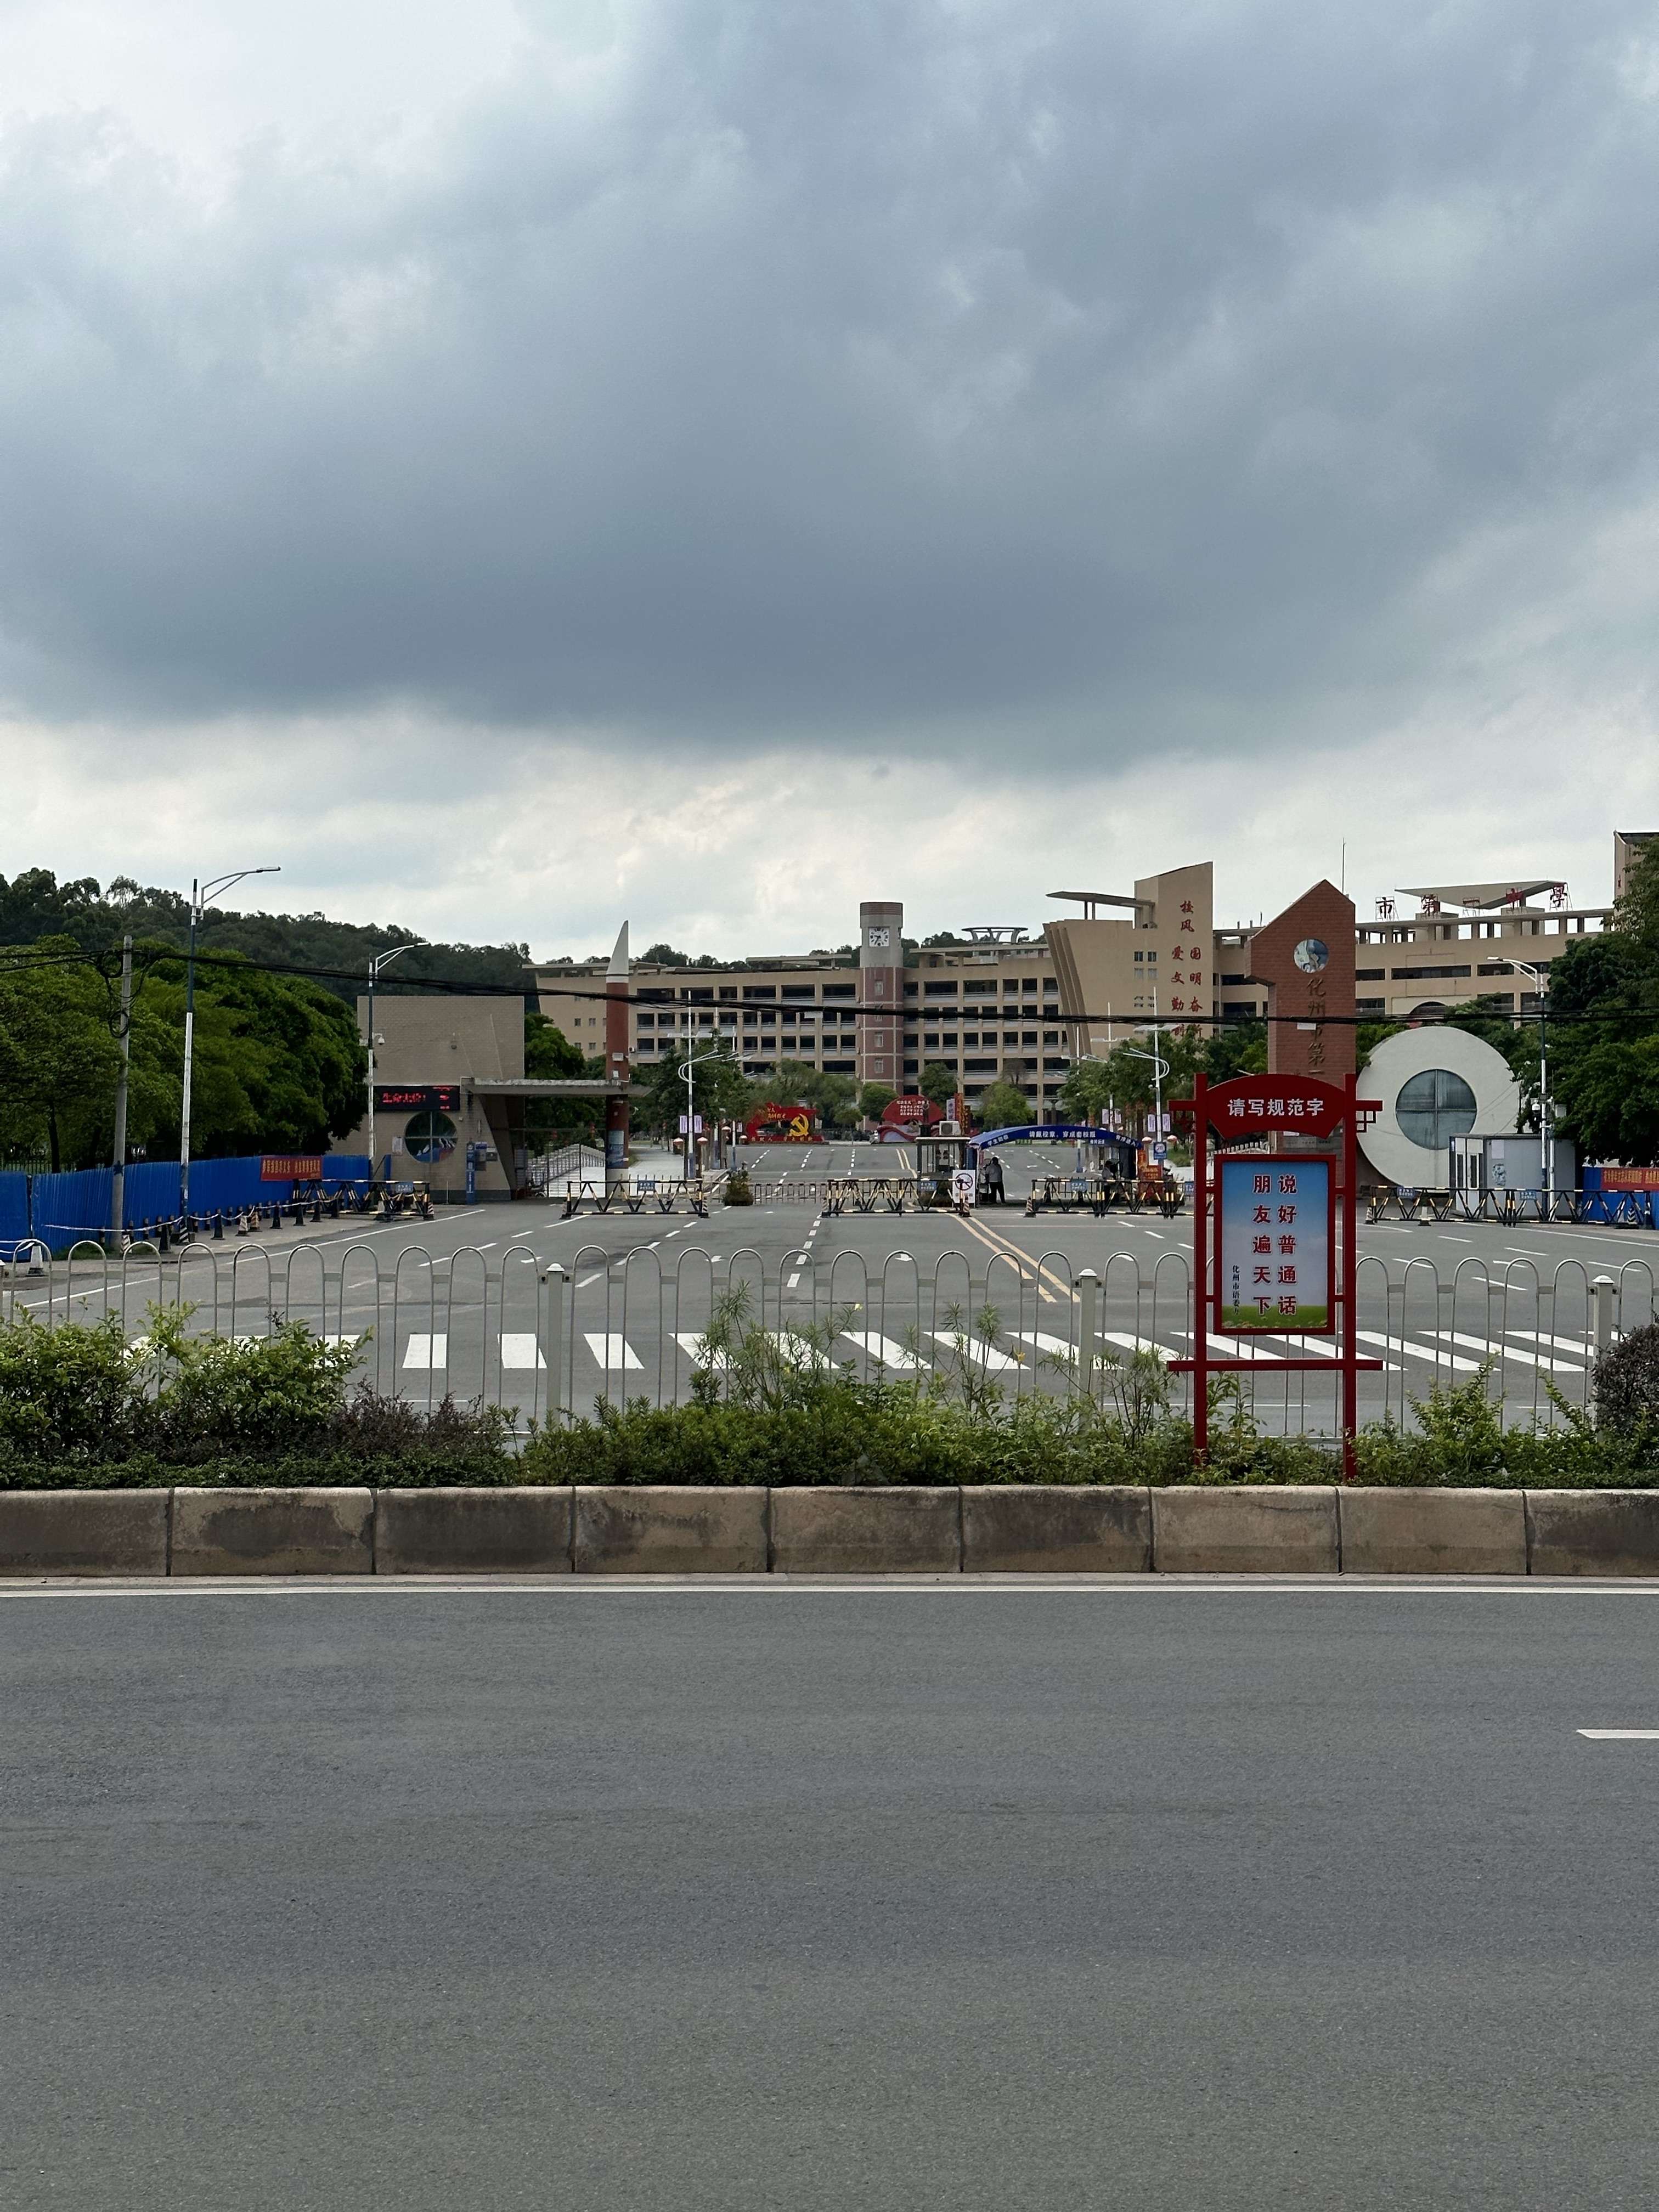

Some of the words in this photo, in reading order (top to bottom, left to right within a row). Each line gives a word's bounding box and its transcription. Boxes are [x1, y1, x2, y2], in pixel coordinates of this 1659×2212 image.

[1180, 900, 1195, 932] 校风
[1172, 946, 1201, 961] 爱国
[1171, 971, 1202, 986] 文明
[1171, 996, 1203, 1012] 勤奋
[1227, 1098, 1324, 1117] 请写规范字
[1253, 1174, 1271, 1315] 朋友遍天下
[1278, 1174, 1297, 1315] 说好普通话
